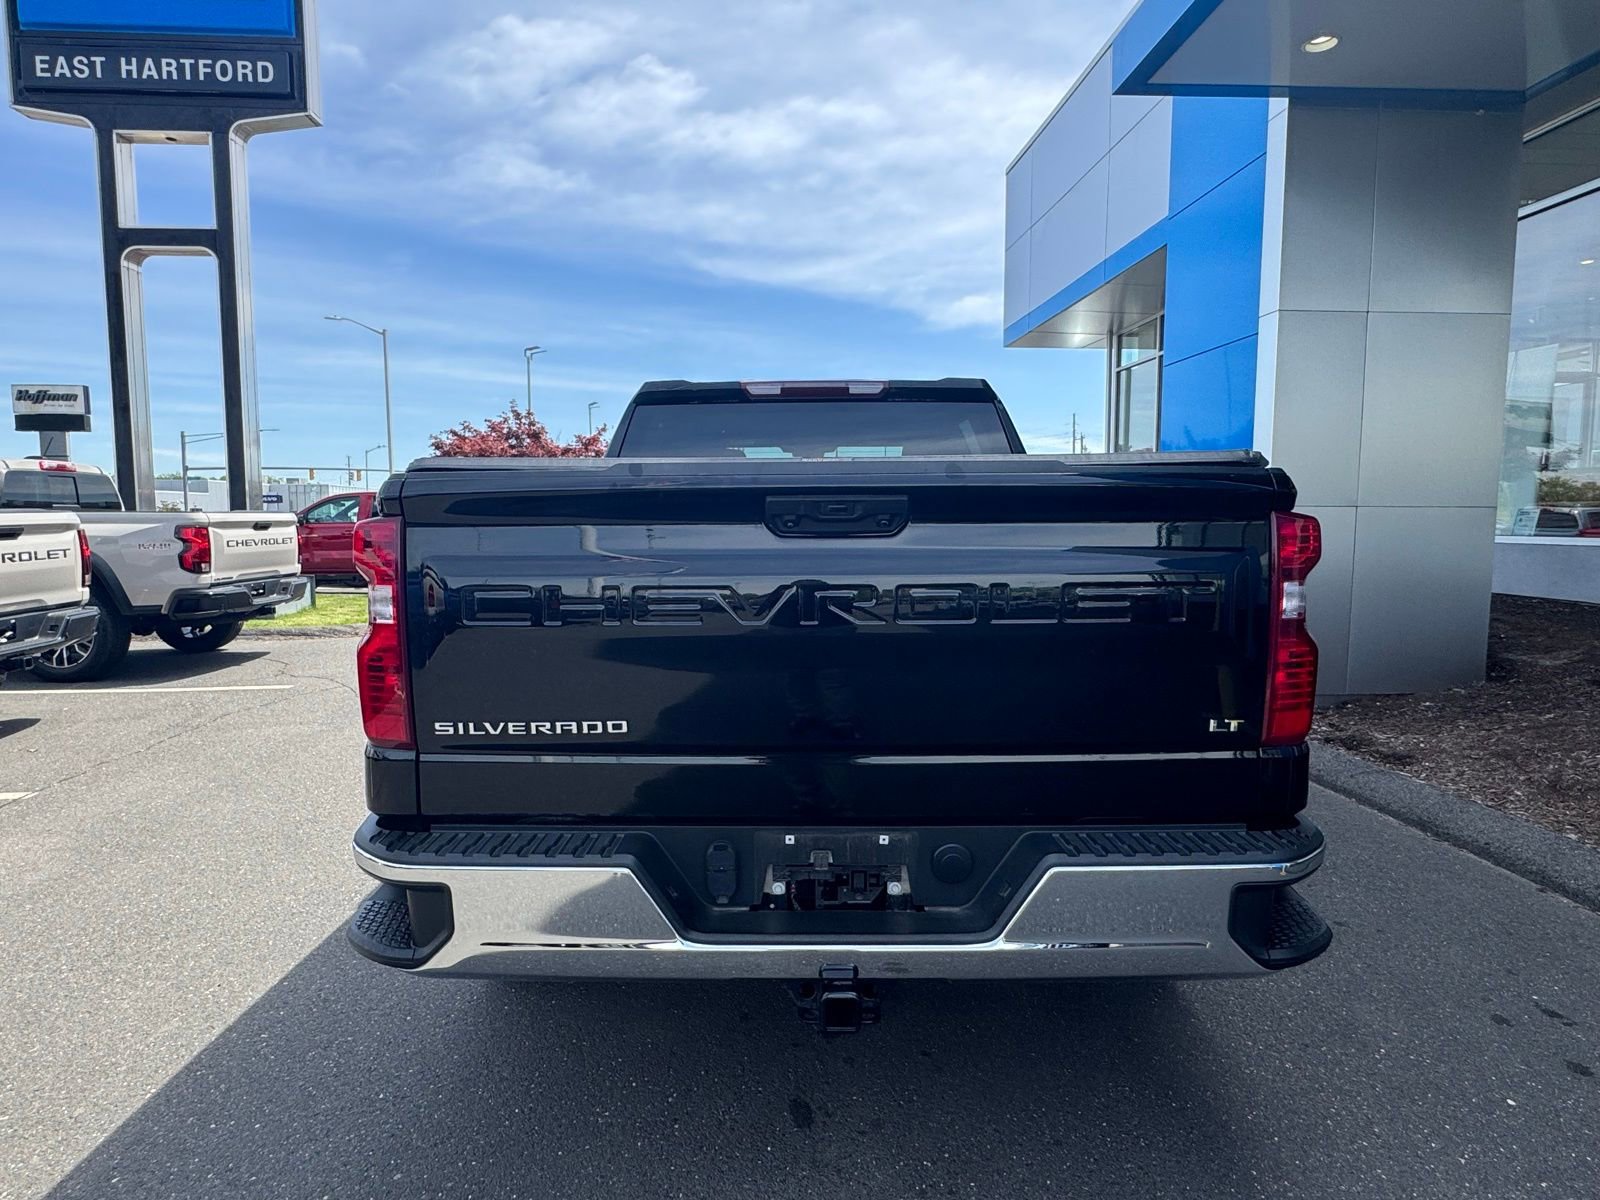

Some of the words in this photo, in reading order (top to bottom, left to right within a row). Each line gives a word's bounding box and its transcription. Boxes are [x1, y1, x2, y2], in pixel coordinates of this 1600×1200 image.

[34, 55, 106, 79] EAST
[120, 57, 275, 83] HARTFORD
[15, 389, 79, 404] Hoffman
[226, 536, 294, 548] CHEVROLET
[1, 548, 71, 564] ROLET
[460, 582, 1217, 627] CHEVROLET
[433, 720, 629, 736] SILVERADO
[1208, 718, 1245, 733] LT
